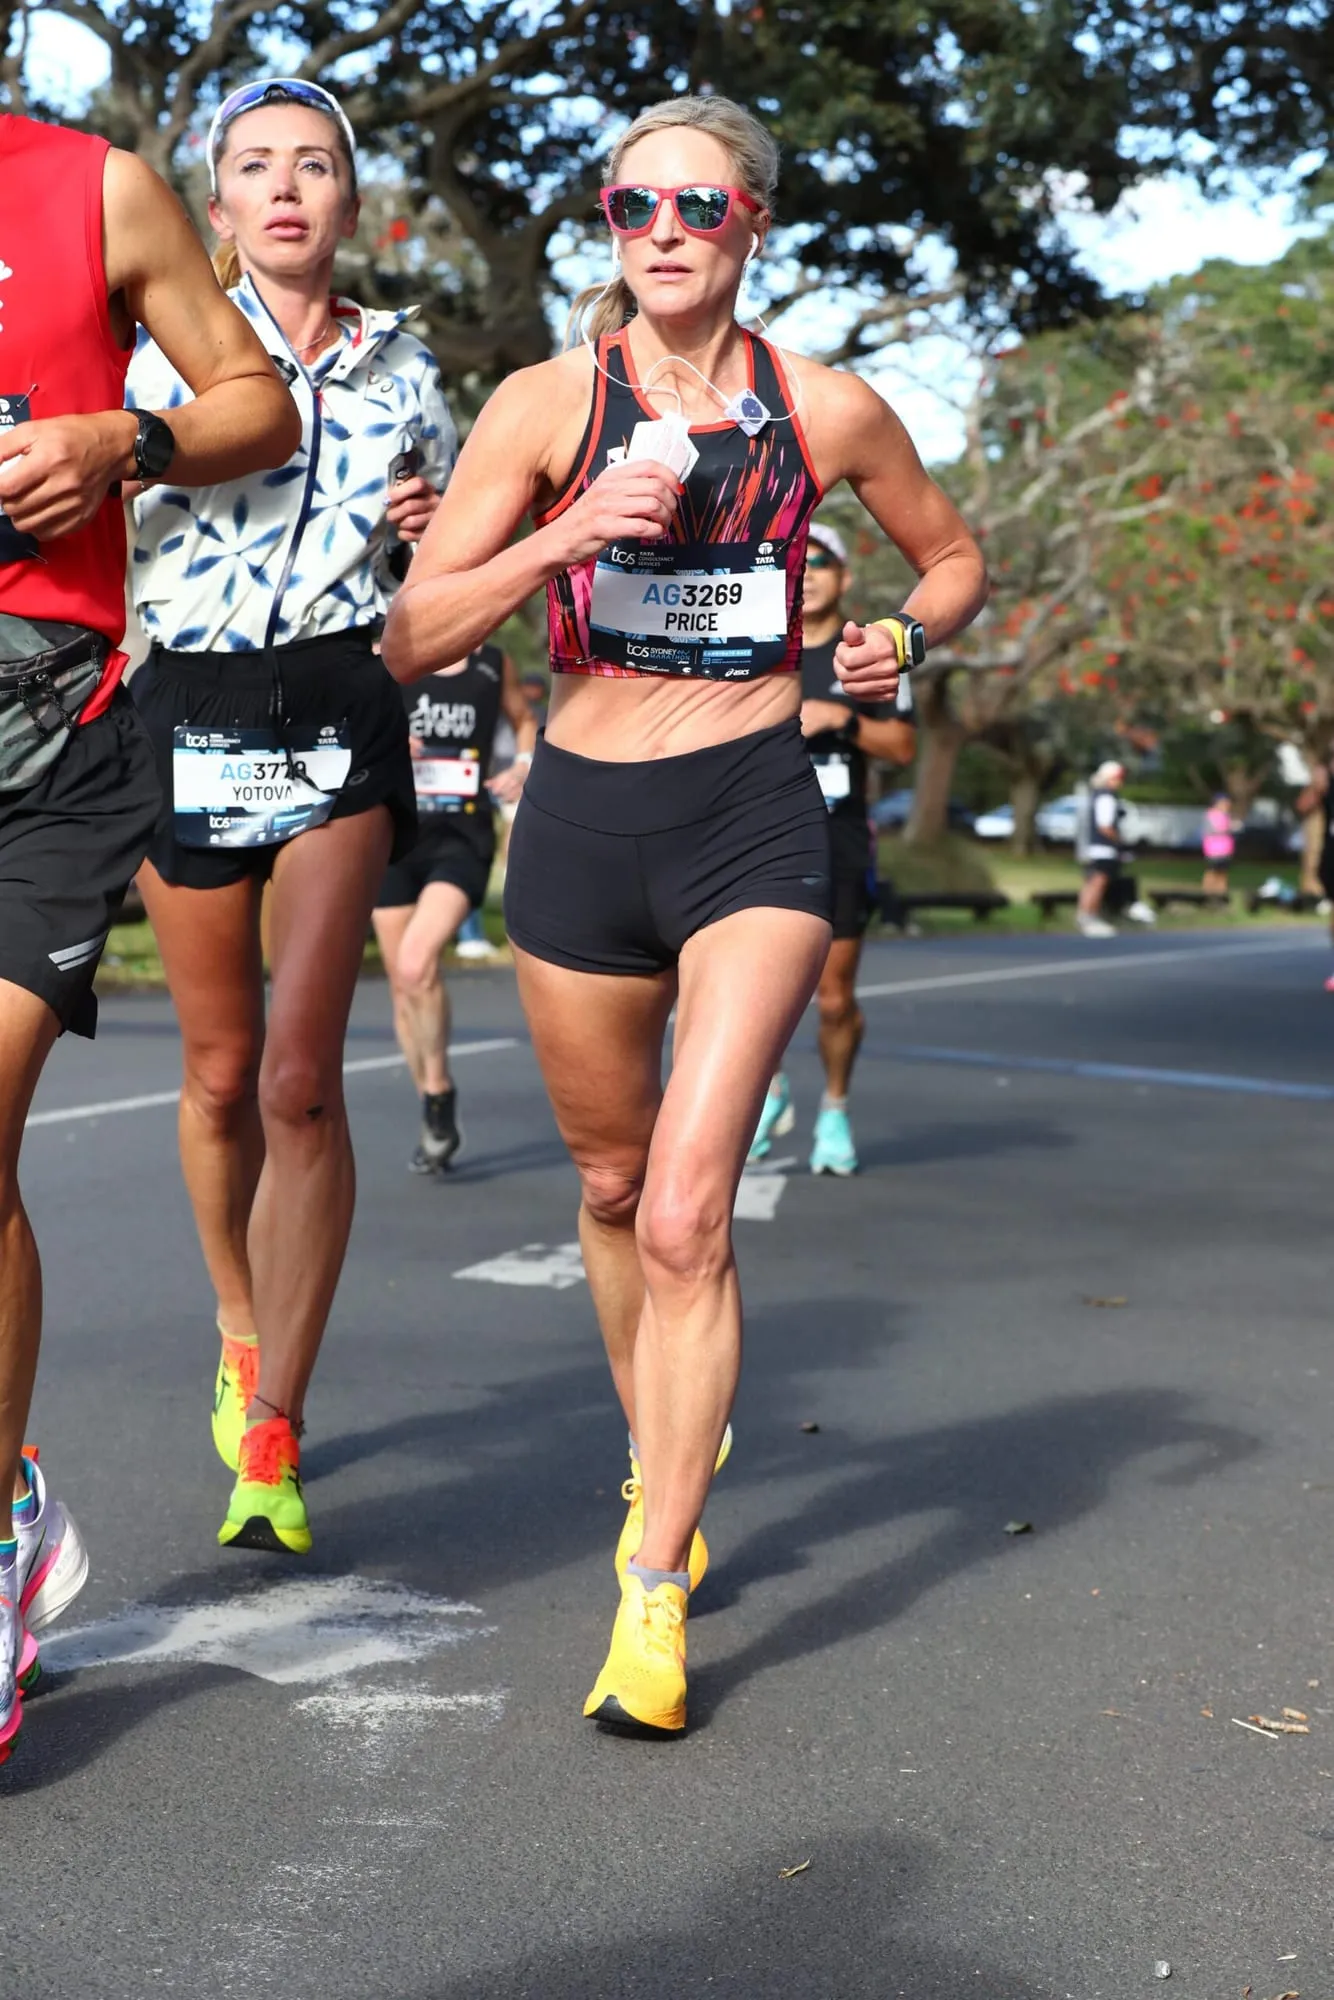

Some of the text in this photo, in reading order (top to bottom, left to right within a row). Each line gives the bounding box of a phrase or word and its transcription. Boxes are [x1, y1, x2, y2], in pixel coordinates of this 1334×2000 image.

[611, 545, 636, 565] tcs
[755, 556, 775, 564] TATA
[642, 583, 743, 607] AG3269
[664, 612, 719, 631] PRICE
[626, 641, 650, 658] tcs
[650, 647, 677, 655] SYDNEY
[185, 732, 209, 748] tcs
[317, 737, 339, 745] TATA
[233, 785, 295, 801] YOTOVA
[209, 814, 231, 828] tcs
